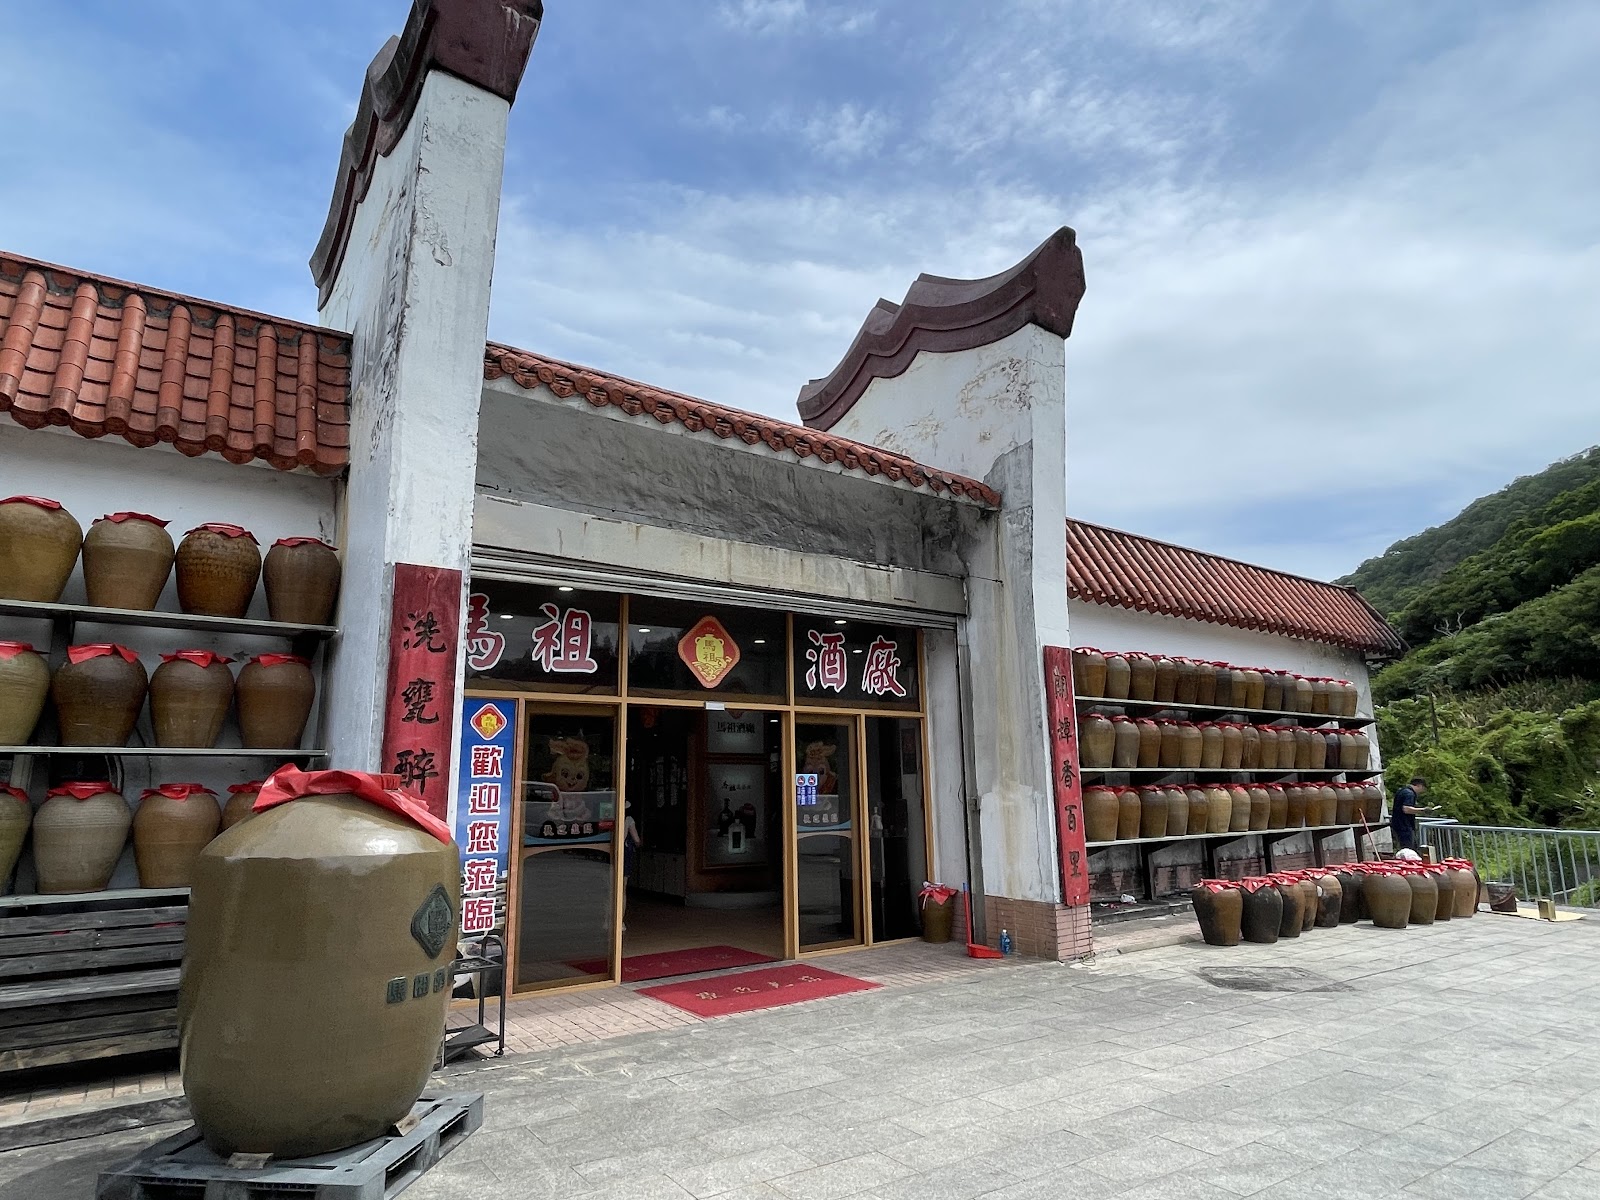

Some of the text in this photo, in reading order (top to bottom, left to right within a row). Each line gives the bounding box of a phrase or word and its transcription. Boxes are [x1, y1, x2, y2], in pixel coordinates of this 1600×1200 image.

[466, 592, 906, 697] 馬祖 酒廠
[462, 744, 504, 933] 歡迎您蒞臨
